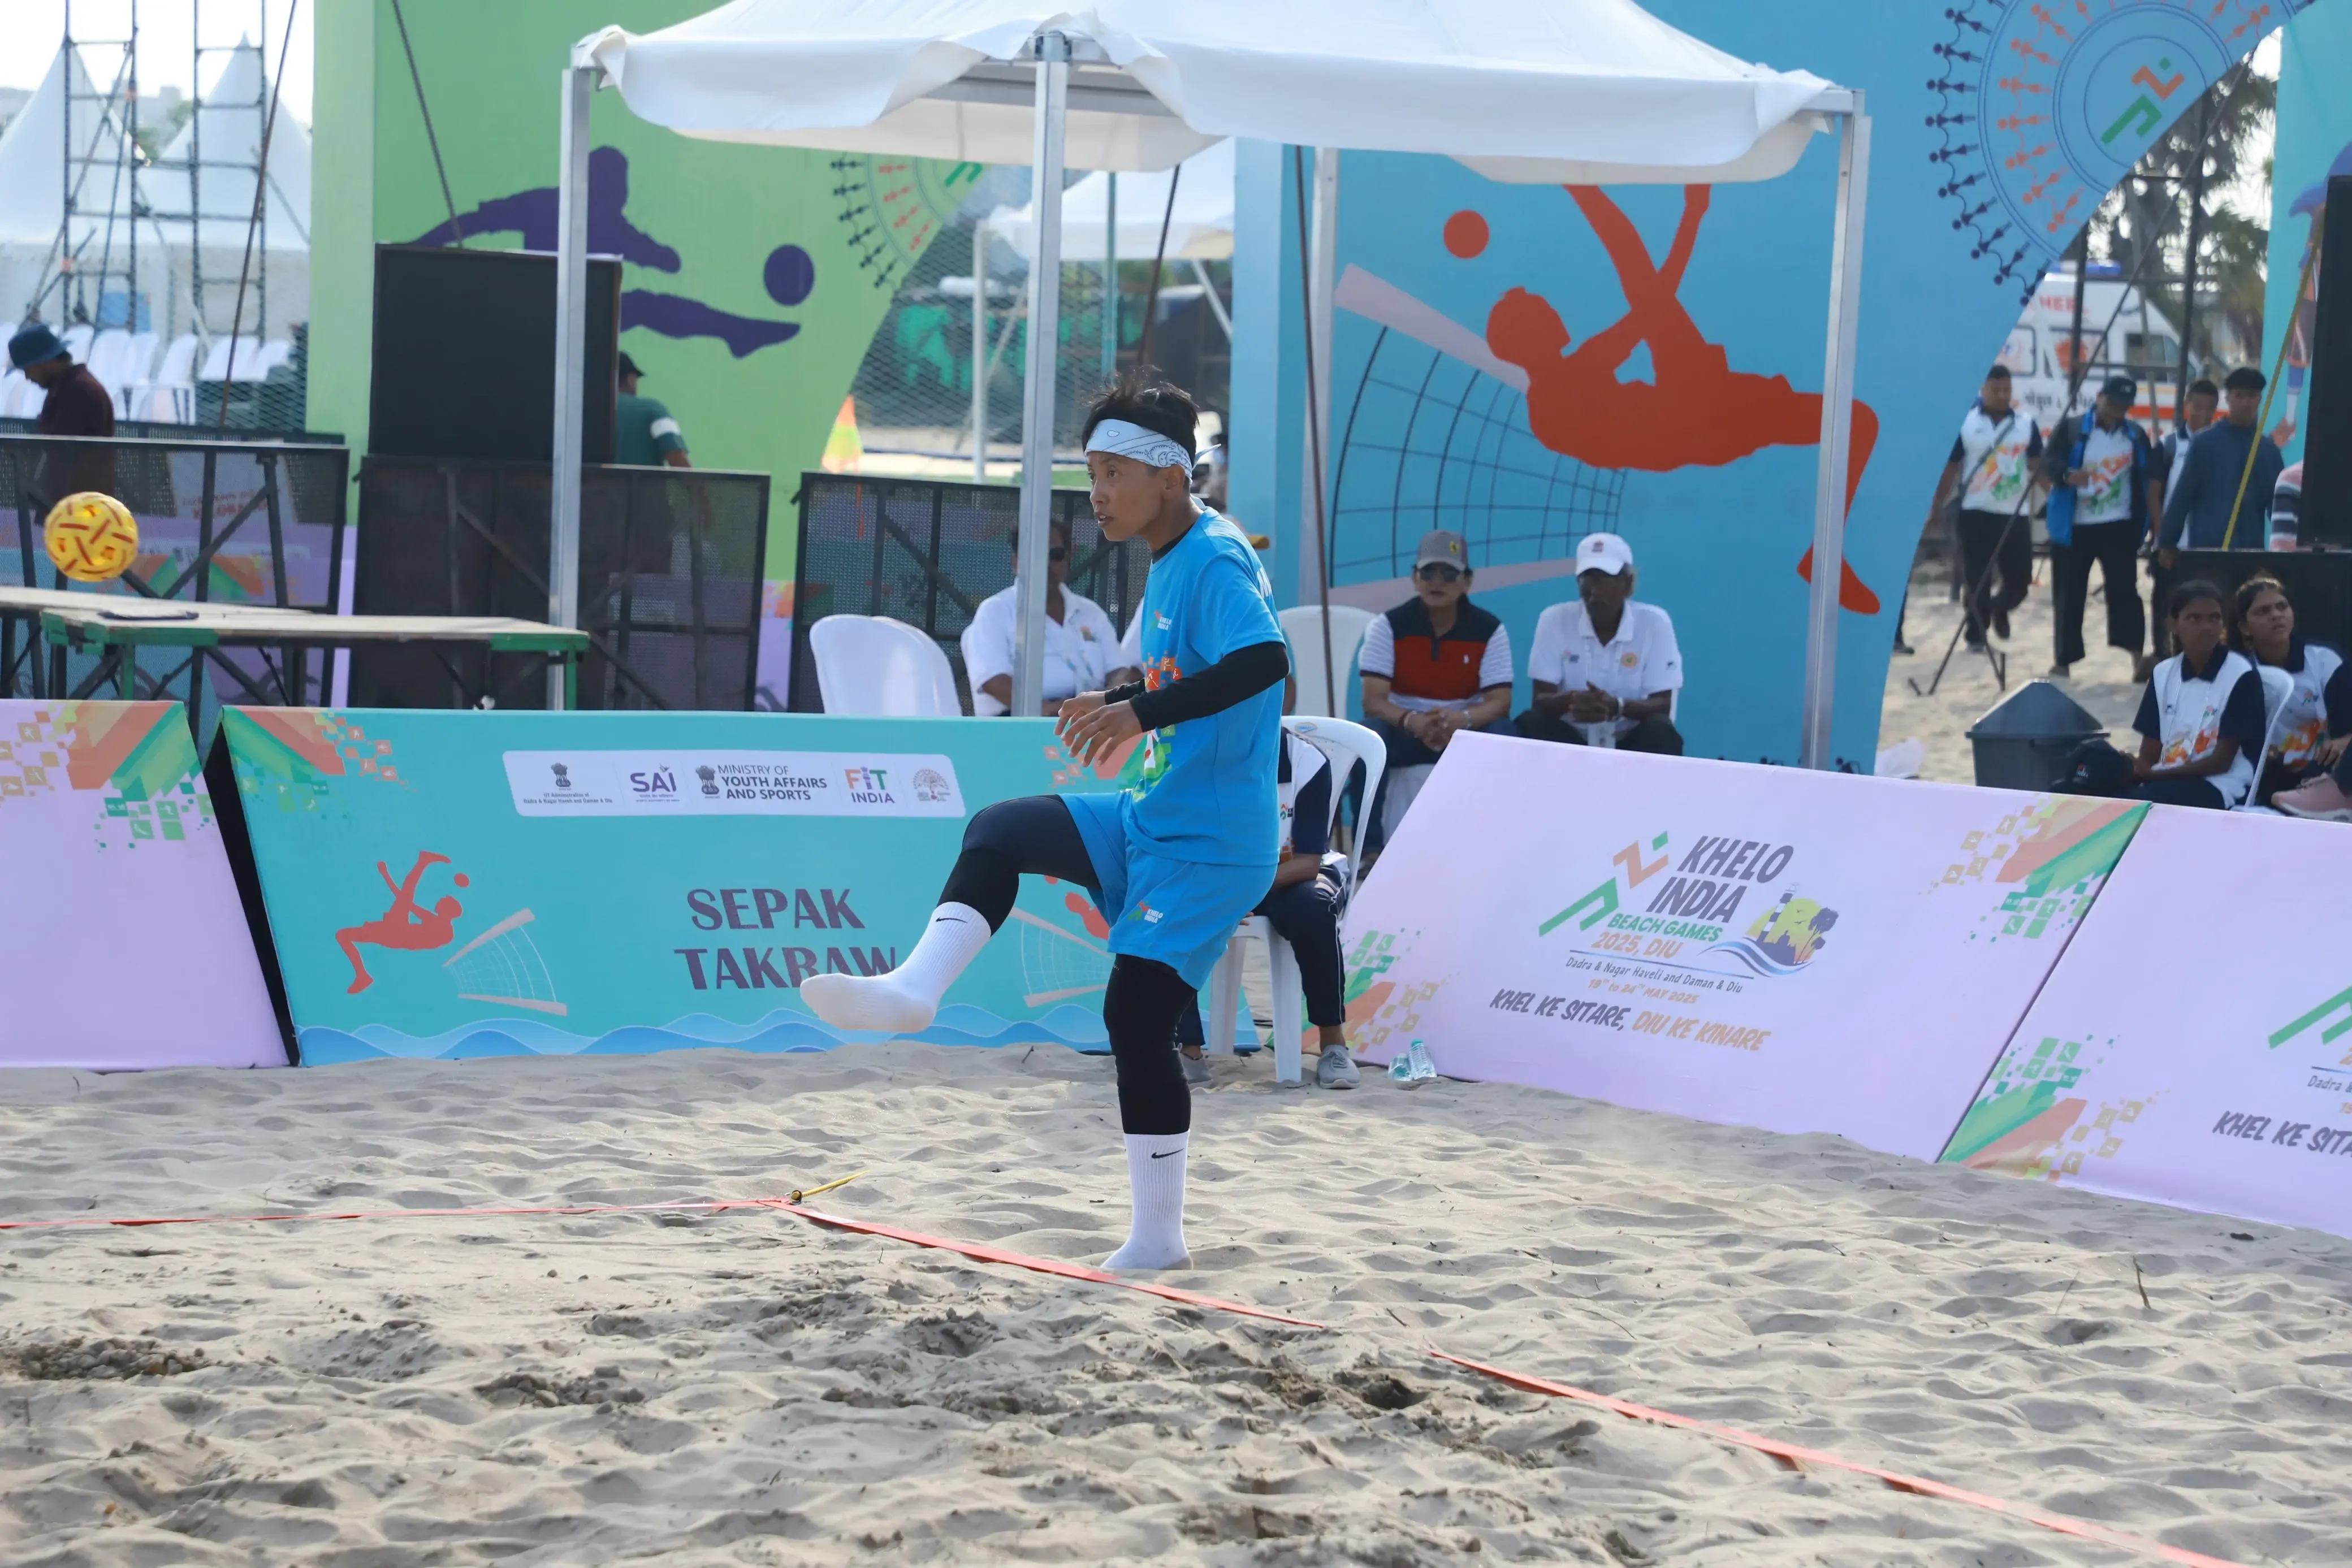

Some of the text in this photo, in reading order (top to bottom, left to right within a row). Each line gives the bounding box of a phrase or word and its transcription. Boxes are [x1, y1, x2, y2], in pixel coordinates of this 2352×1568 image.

[630, 772, 677, 792] SAI
[717, 765, 789, 775] MINISTRY OF
[721, 776, 827, 788] YOUTH AFFAIRS
[727, 789, 811, 800] AND SPORTS
[851, 792, 895, 803] INDIA
[1677, 835, 1793, 883] KHELO
[687, 888, 866, 930] SEPAK
[1646, 877, 1748, 923] INDIA
[1607, 913, 1723, 942] BEACH GAMES
[1592, 932, 1684, 958] 2025, DIU
[1566, 957, 1743, 993] Dadra & Nagar Haveli and Daman & Diu
[1609, 982, 1619, 992] to
[1643, 987, 1668, 999] MAY
[1668, 993, 1701, 1004] 2025
[1489, 988, 1772, 1051] KHEL KE SITARE, DIU KE KINARE
[2307, 1075, 2342, 1091] Dadra
[2212, 1110, 2271, 1141] KHEL
[2271, 1120, 2311, 1146] KE
